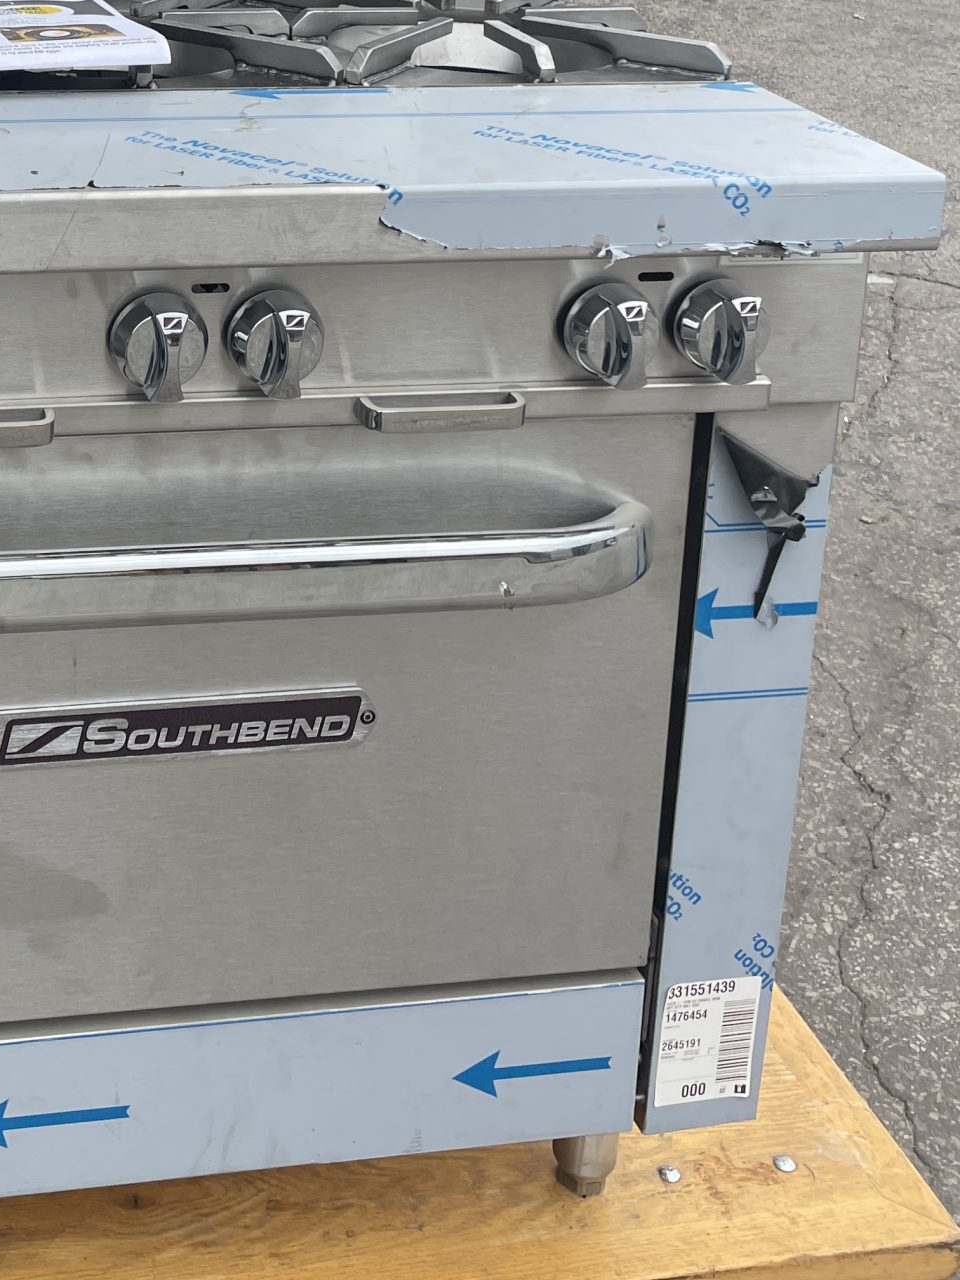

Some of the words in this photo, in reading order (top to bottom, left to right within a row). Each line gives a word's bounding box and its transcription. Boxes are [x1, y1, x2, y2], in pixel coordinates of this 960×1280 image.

[140, 130, 178, 143] The
[482, 124, 525, 137] The
[124, 135, 150, 146] for
[152, 142, 215, 160] LASER
[217, 155, 269, 172] Fiber
[506, 137, 571, 153] LASER
[575, 149, 633, 166] Fiber
[668, 980, 736, 1000] 331551439
[666, 1009, 708, 1023] 1476454
[661, 1038, 701, 1052] 2645191
[681, 1082, 706, 1098] 000
